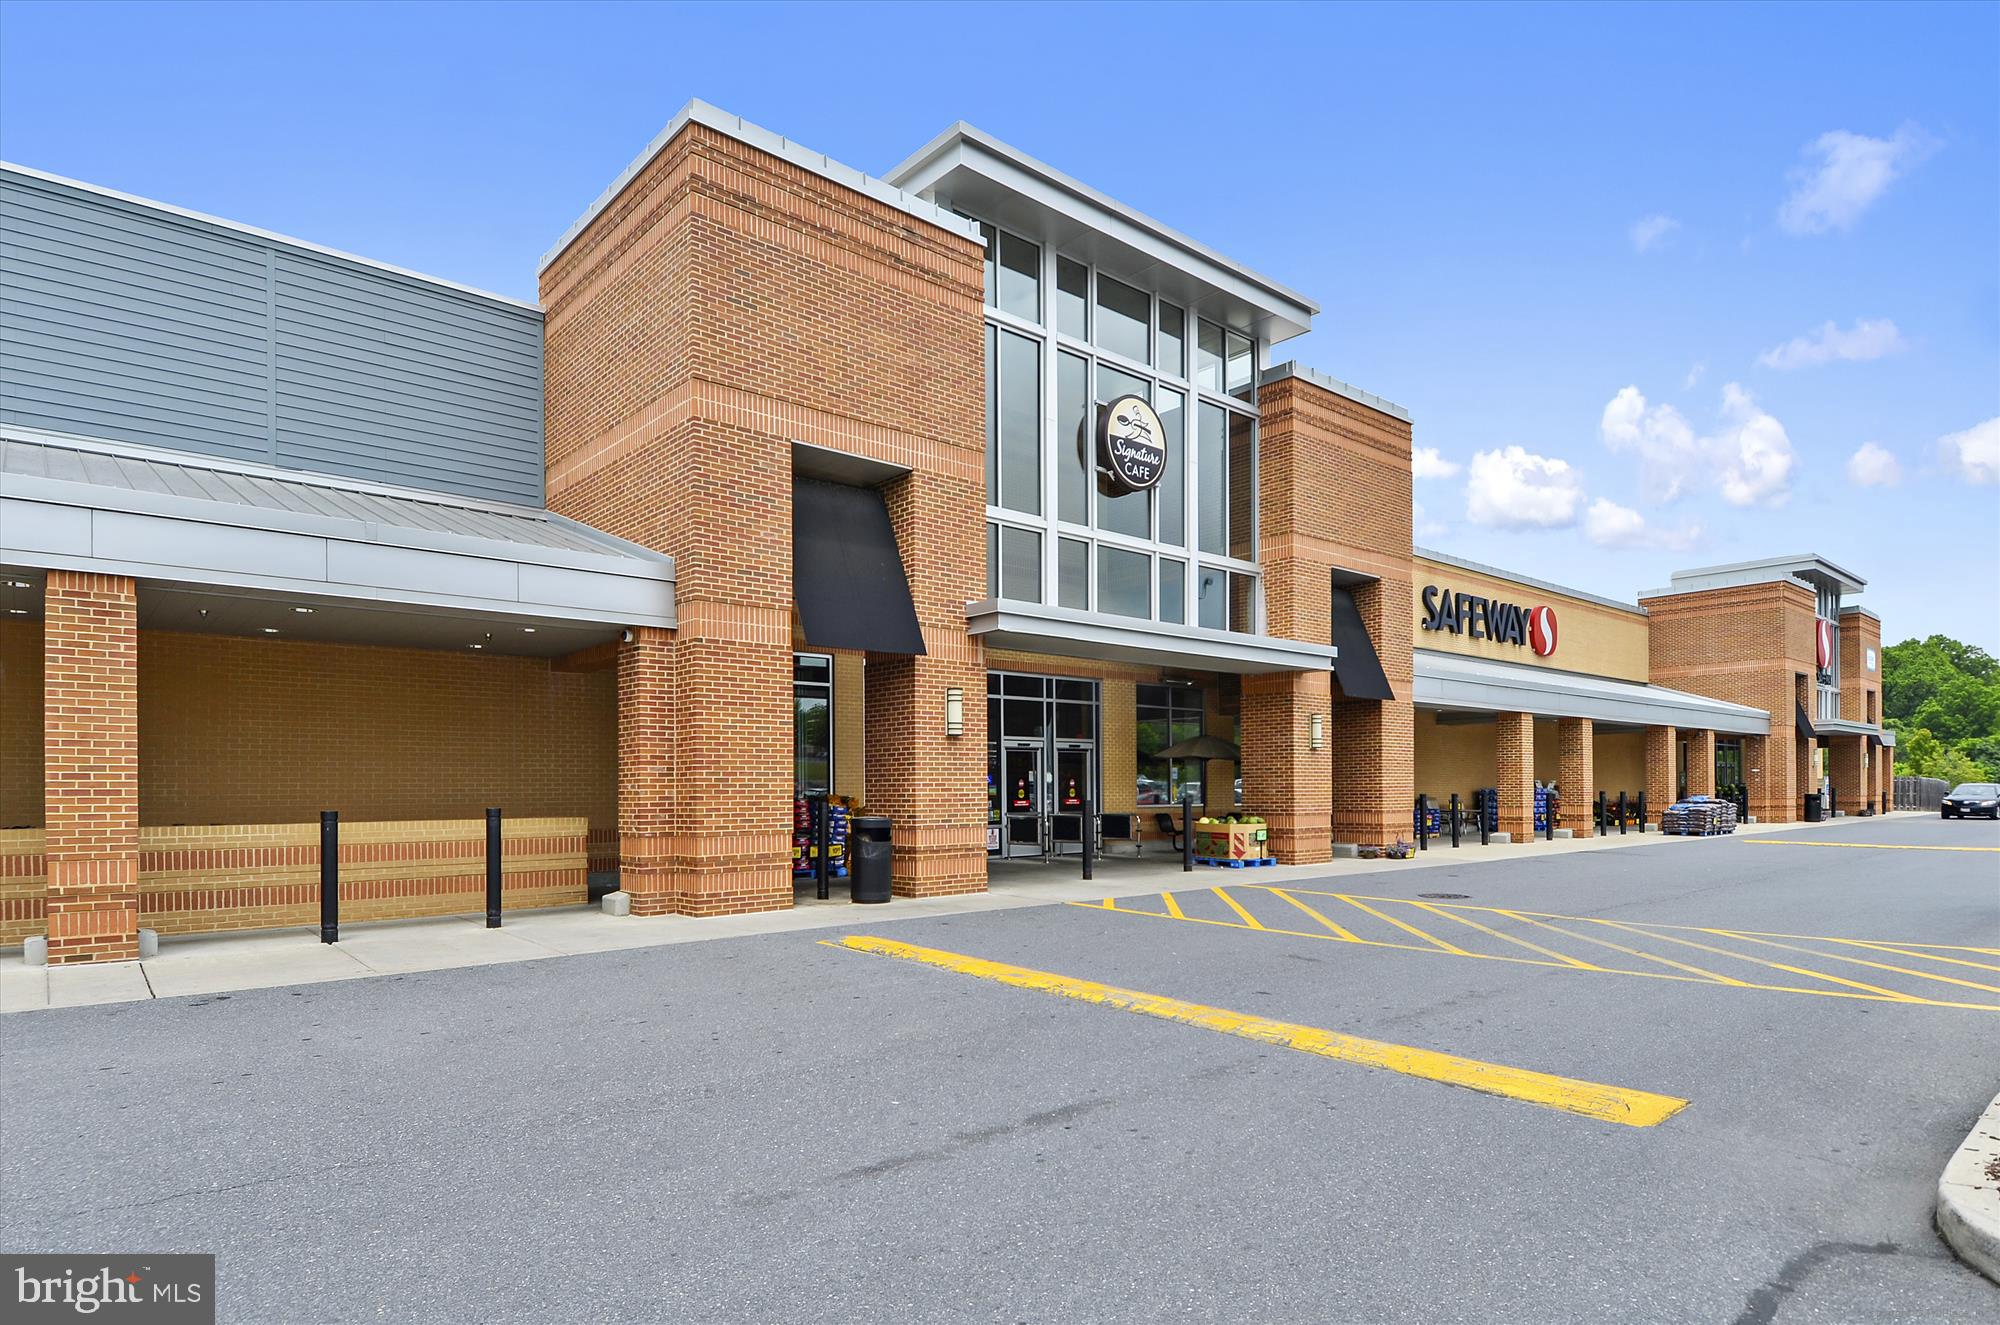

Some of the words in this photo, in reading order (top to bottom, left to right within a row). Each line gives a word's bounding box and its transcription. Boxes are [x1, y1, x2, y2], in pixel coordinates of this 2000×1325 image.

[1114, 439, 1161, 466] Signature
[1124, 463, 1150, 480] CAFE
[1421, 585, 1532, 646] SAFEWAY
